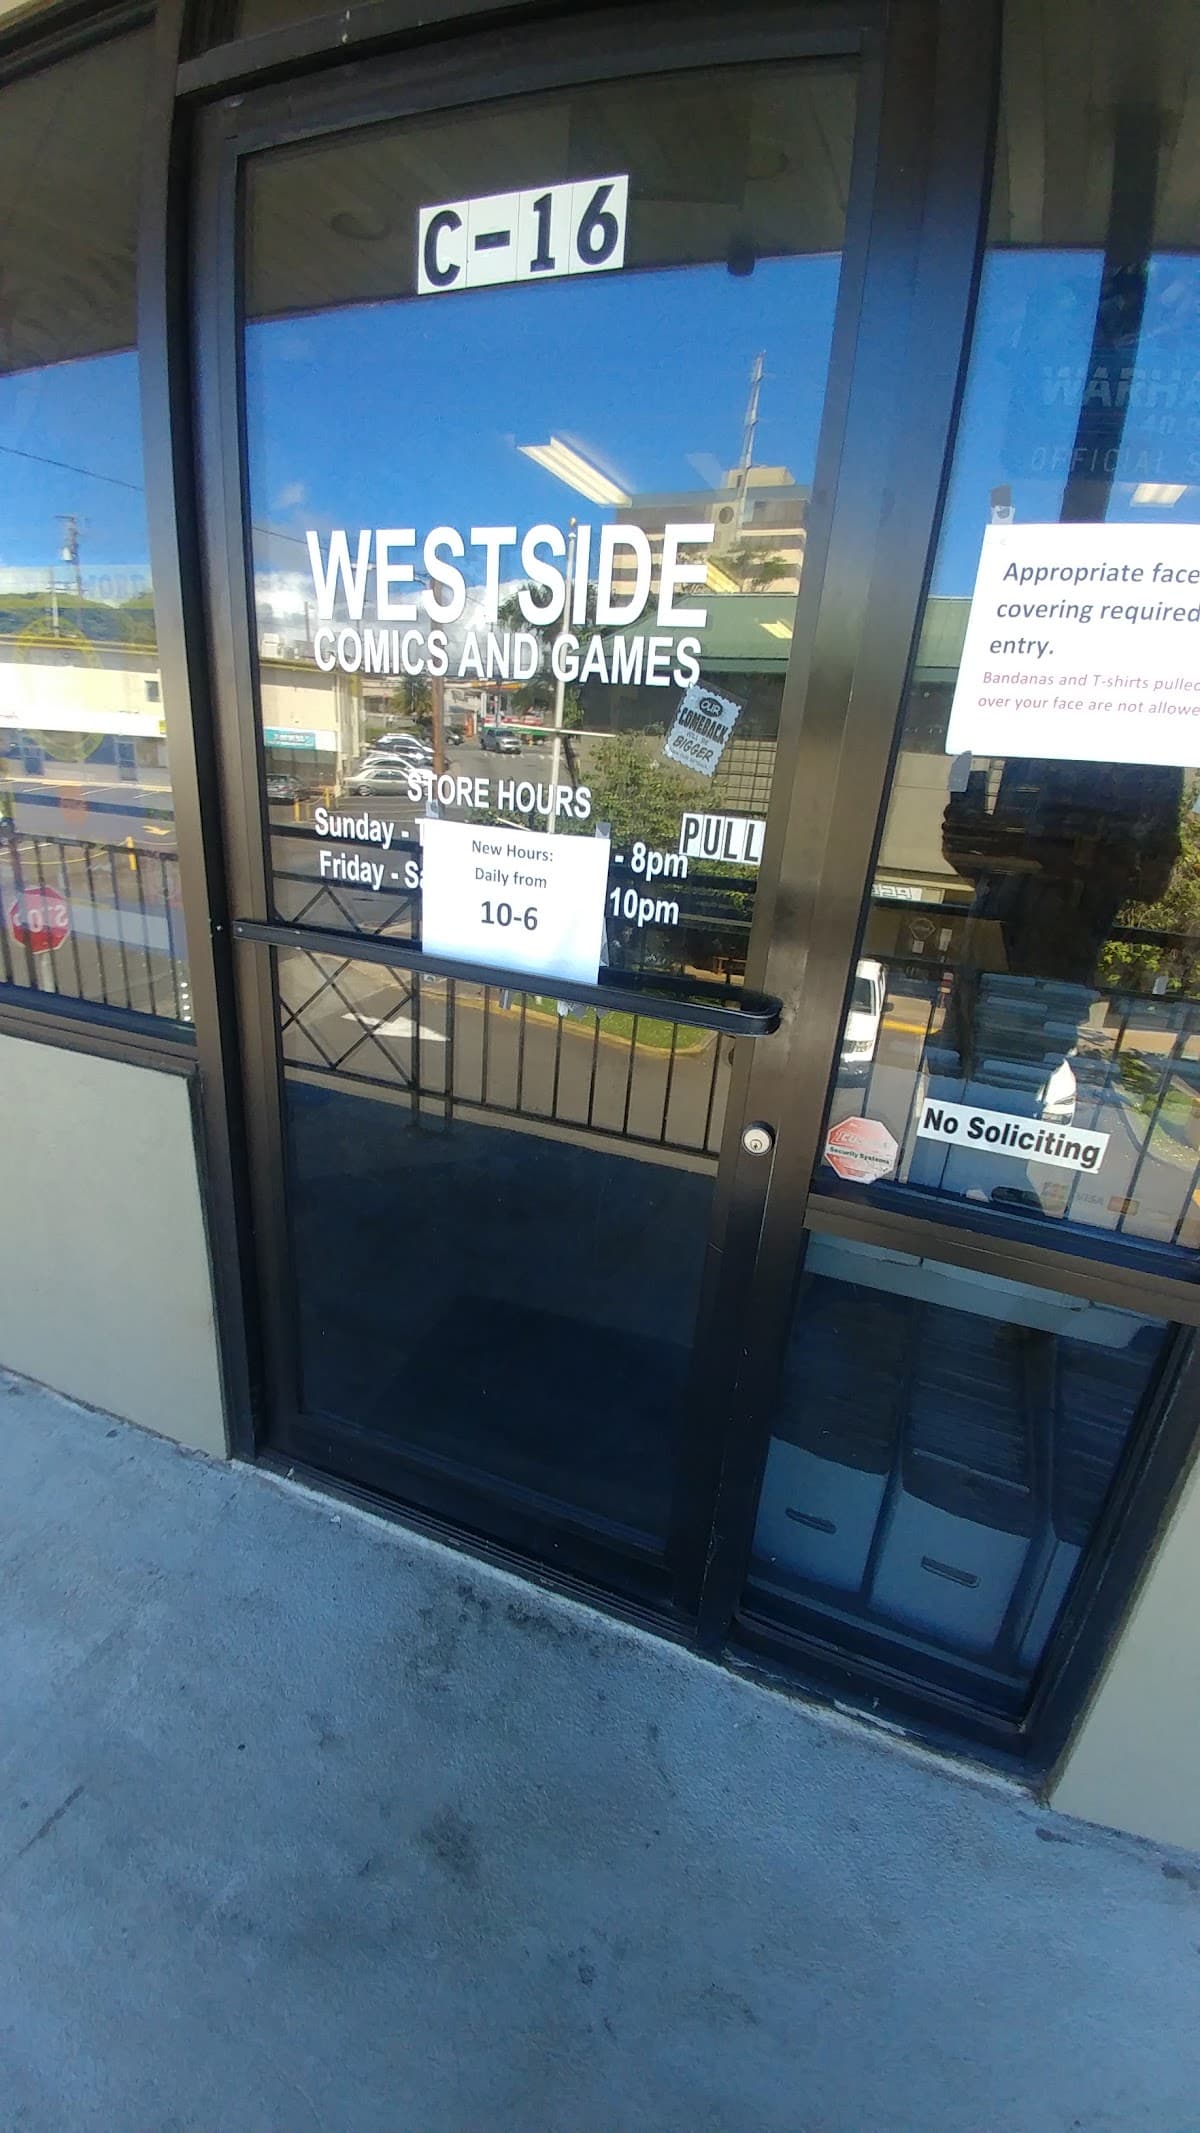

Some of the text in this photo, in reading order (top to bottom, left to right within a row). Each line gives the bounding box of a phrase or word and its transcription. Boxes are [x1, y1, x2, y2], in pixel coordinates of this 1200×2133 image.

[424, 184, 619, 287] C-16
[306, 523, 715, 627] WESTSIDE
[1003, 562, 1200, 586] Appropriate face
[997, 599, 1200, 625] covering required
[313, 626, 701, 688] COMICS AND GAMES
[989, 637, 1054, 659] entry.
[983, 671, 1054, 685] Bandanas
[1059, 674, 1088, 687] and
[1093, 674, 1149, 689] T-shirts
[700, 700, 721, 716] OUR
[978, 697, 1010, 708] over
[1015, 698, 1049, 711] your
[1053, 696, 1083, 711] face
[1088, 701, 1113, 712] are
[1117, 701, 1144, 714] not
[679, 707, 730, 744] COMEBACK
[673, 736, 714, 762] BIGGER
[407, 768, 592, 819] STORE HOURS
[314, 806, 395, 850] Sunday
[682, 817, 759, 863] PULL
[472, 839, 553, 862] New Hours:
[630, 841, 689, 882] 8pm
[319, 850, 384, 891] Friday
[475, 867, 547, 888] Daily from
[481, 900, 538, 931] 10-6
[609, 886, 680, 928] 10pm
[924, 1107, 1100, 1169] No Soliciting
[829, 1146, 890, 1165] Security Systems
